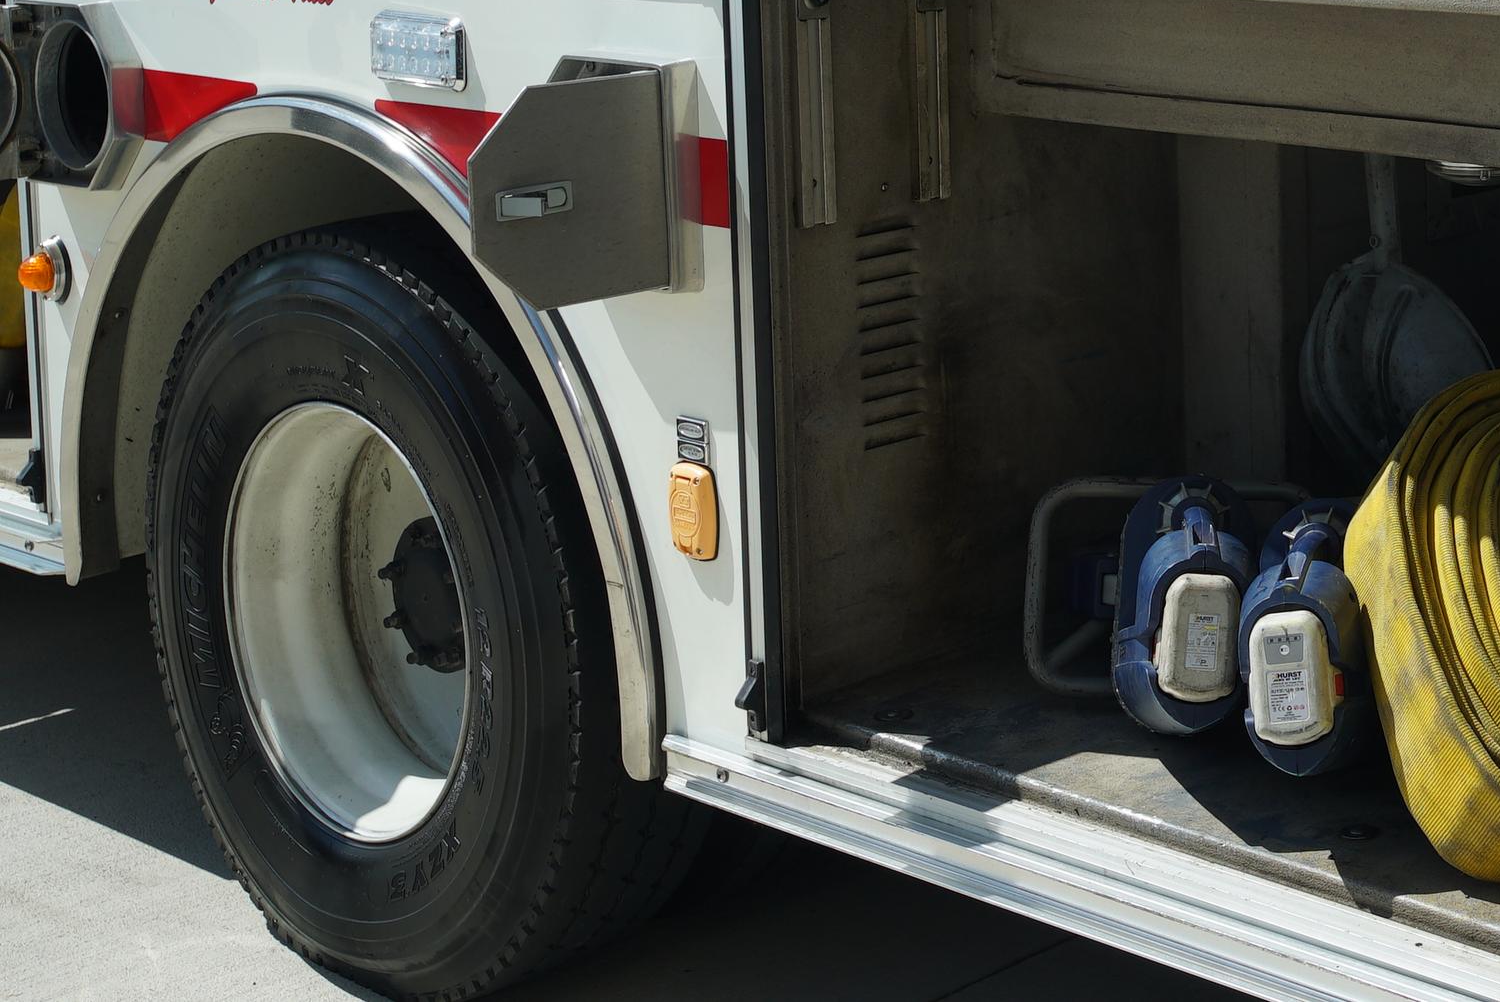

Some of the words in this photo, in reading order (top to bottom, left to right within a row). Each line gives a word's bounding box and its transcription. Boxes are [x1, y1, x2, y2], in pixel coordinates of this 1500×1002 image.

[182, 406, 230, 689] MICHELIN
[1276, 671, 1302, 679] HURST
[386, 817, 462, 903] XZY3
